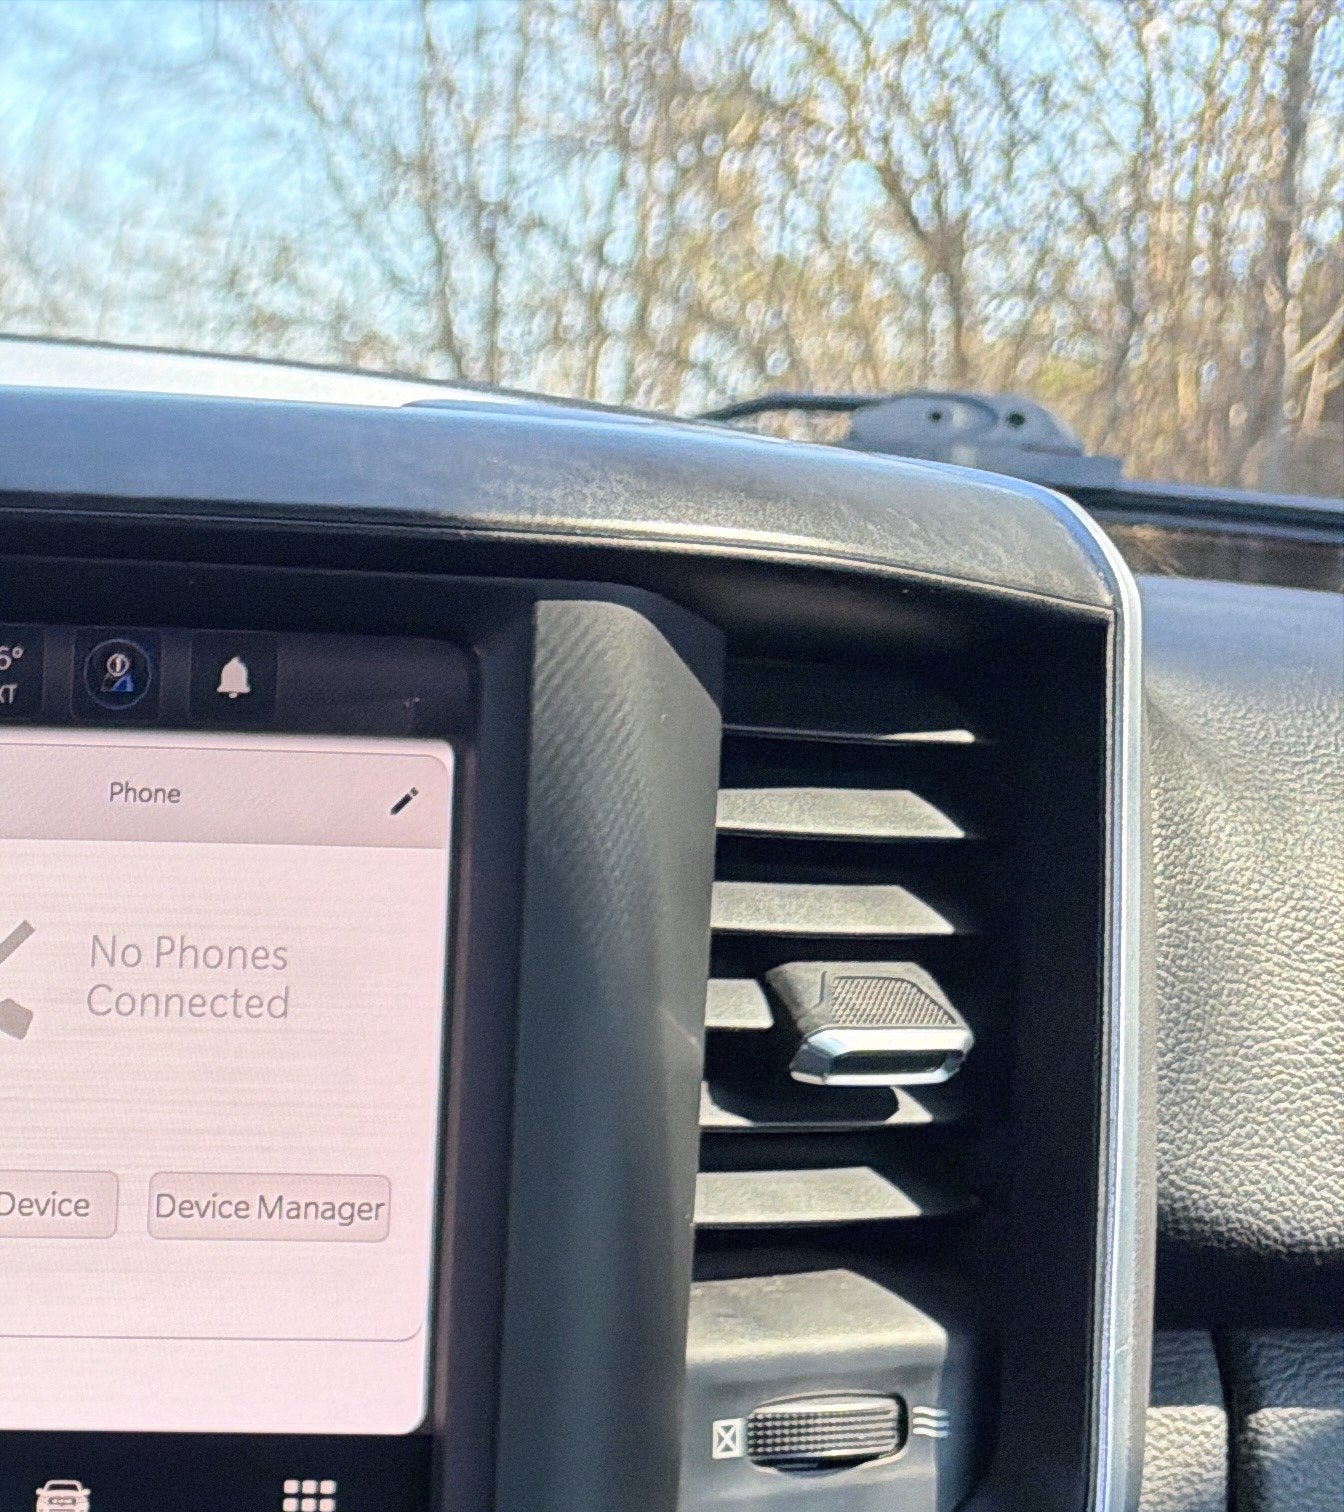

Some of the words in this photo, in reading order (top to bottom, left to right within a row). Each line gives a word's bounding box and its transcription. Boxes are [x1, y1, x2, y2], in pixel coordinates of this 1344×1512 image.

[108, 780, 182, 805] Phone
[89, 934, 142, 971] No
[154, 935, 289, 973] Phones
[86, 983, 290, 1021] Connected
[155, 1192, 251, 1220] Device
[256, 1194, 386, 1226] Manager
